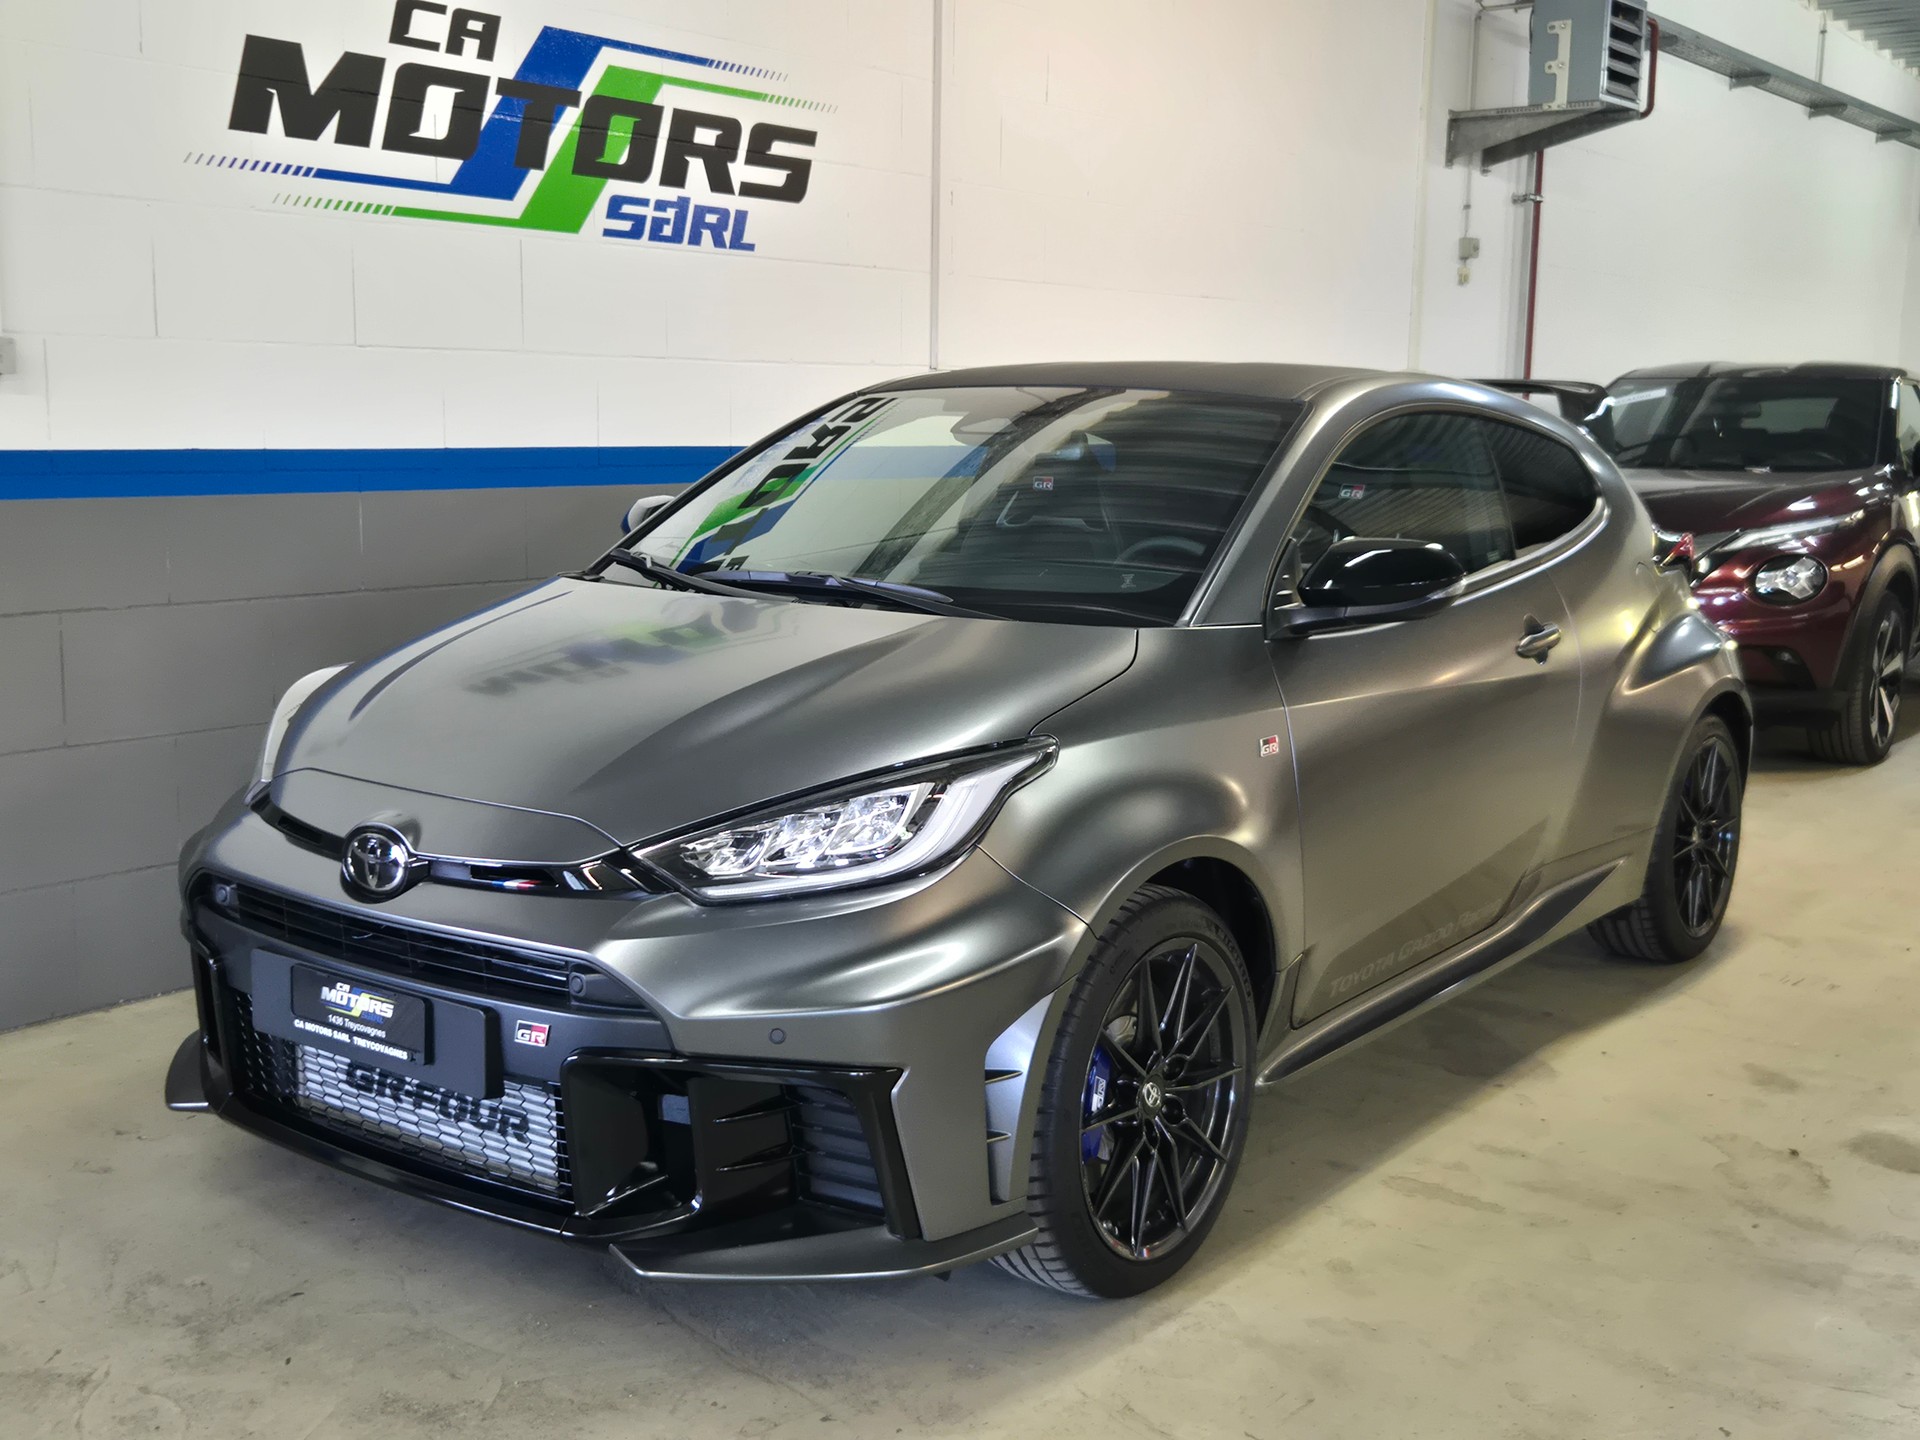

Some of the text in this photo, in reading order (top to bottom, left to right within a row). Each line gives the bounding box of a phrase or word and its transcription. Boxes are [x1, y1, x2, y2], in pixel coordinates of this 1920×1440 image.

[389, 0, 502, 62] CA
[228, 34, 818, 204] MOTORS
[336, 982, 351, 992] CA
[1328, 951, 1395, 999] TOYOTA
[321, 986, 395, 1018] MOTORS
[293, 1019, 304, 1029] CA
[304, 1021, 333, 1038] MOTORS
[333, 1030, 351, 1043] SARL
[344, 1017, 386, 1038] Treycovagnes
